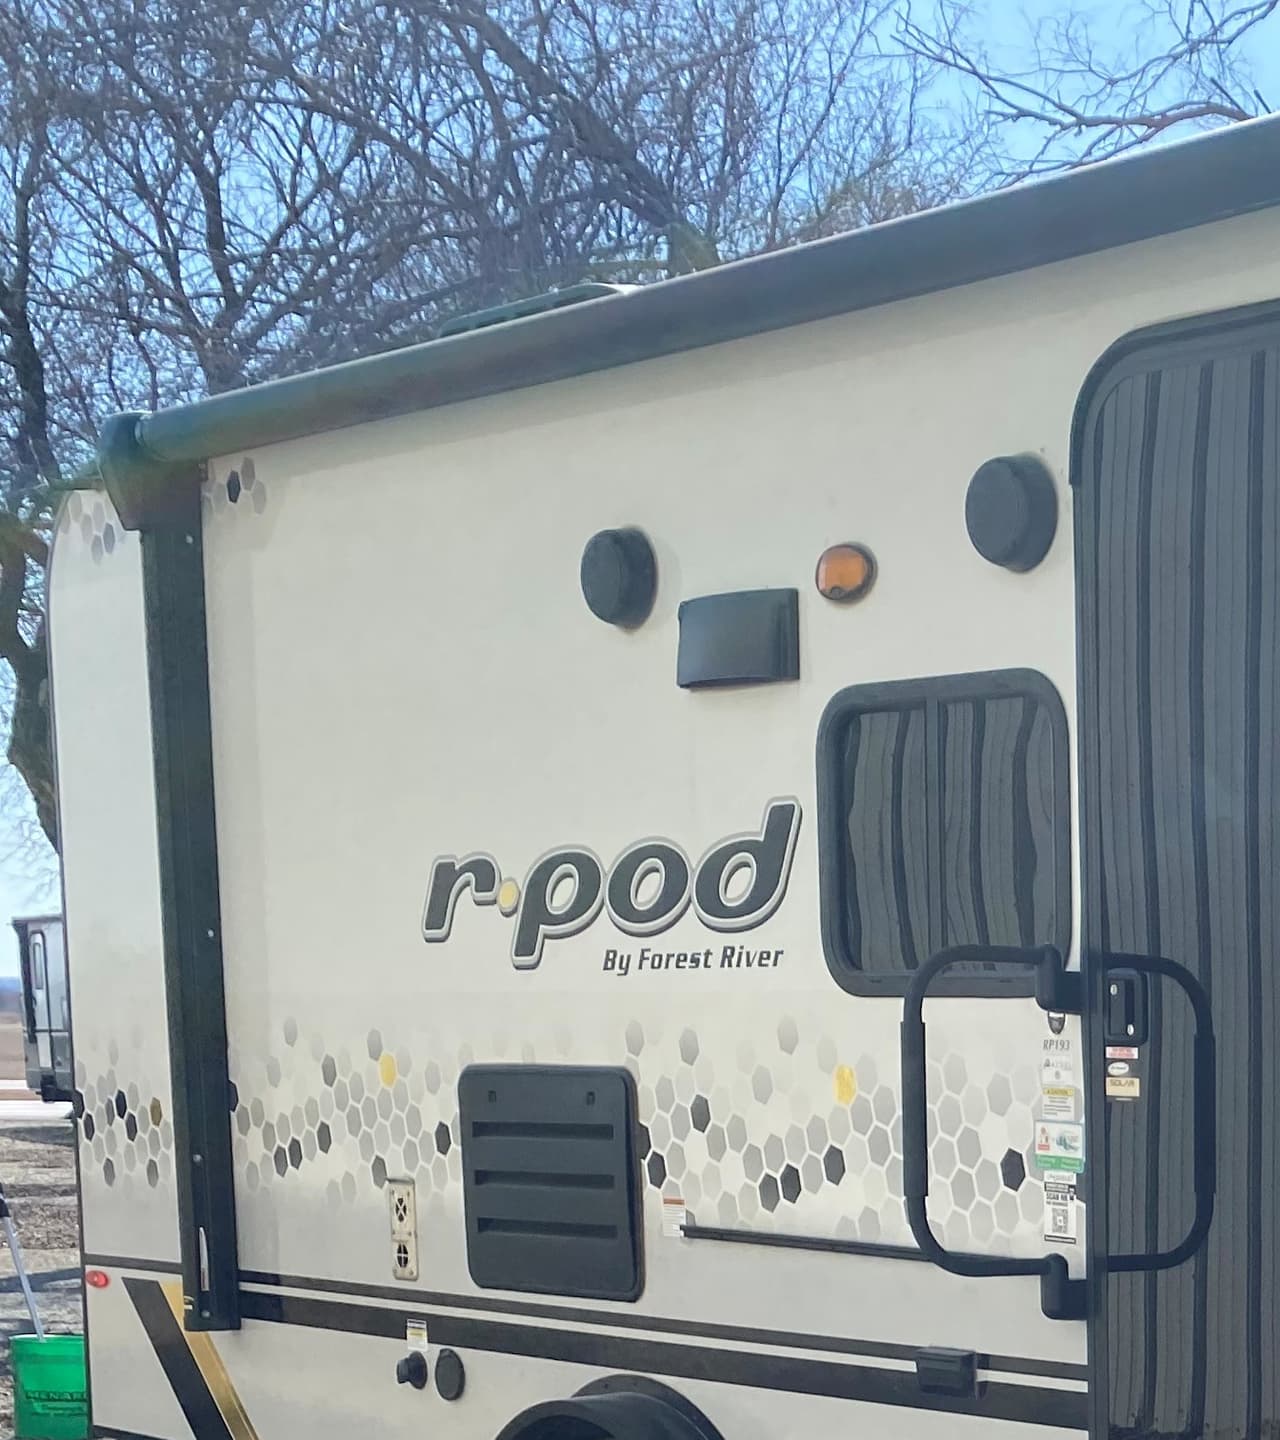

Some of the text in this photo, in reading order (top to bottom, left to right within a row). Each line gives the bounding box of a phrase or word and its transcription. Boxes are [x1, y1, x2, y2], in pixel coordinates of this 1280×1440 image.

[603, 945, 784, 976] By Forest River
[1043, 1039, 1070, 1051] RP193
